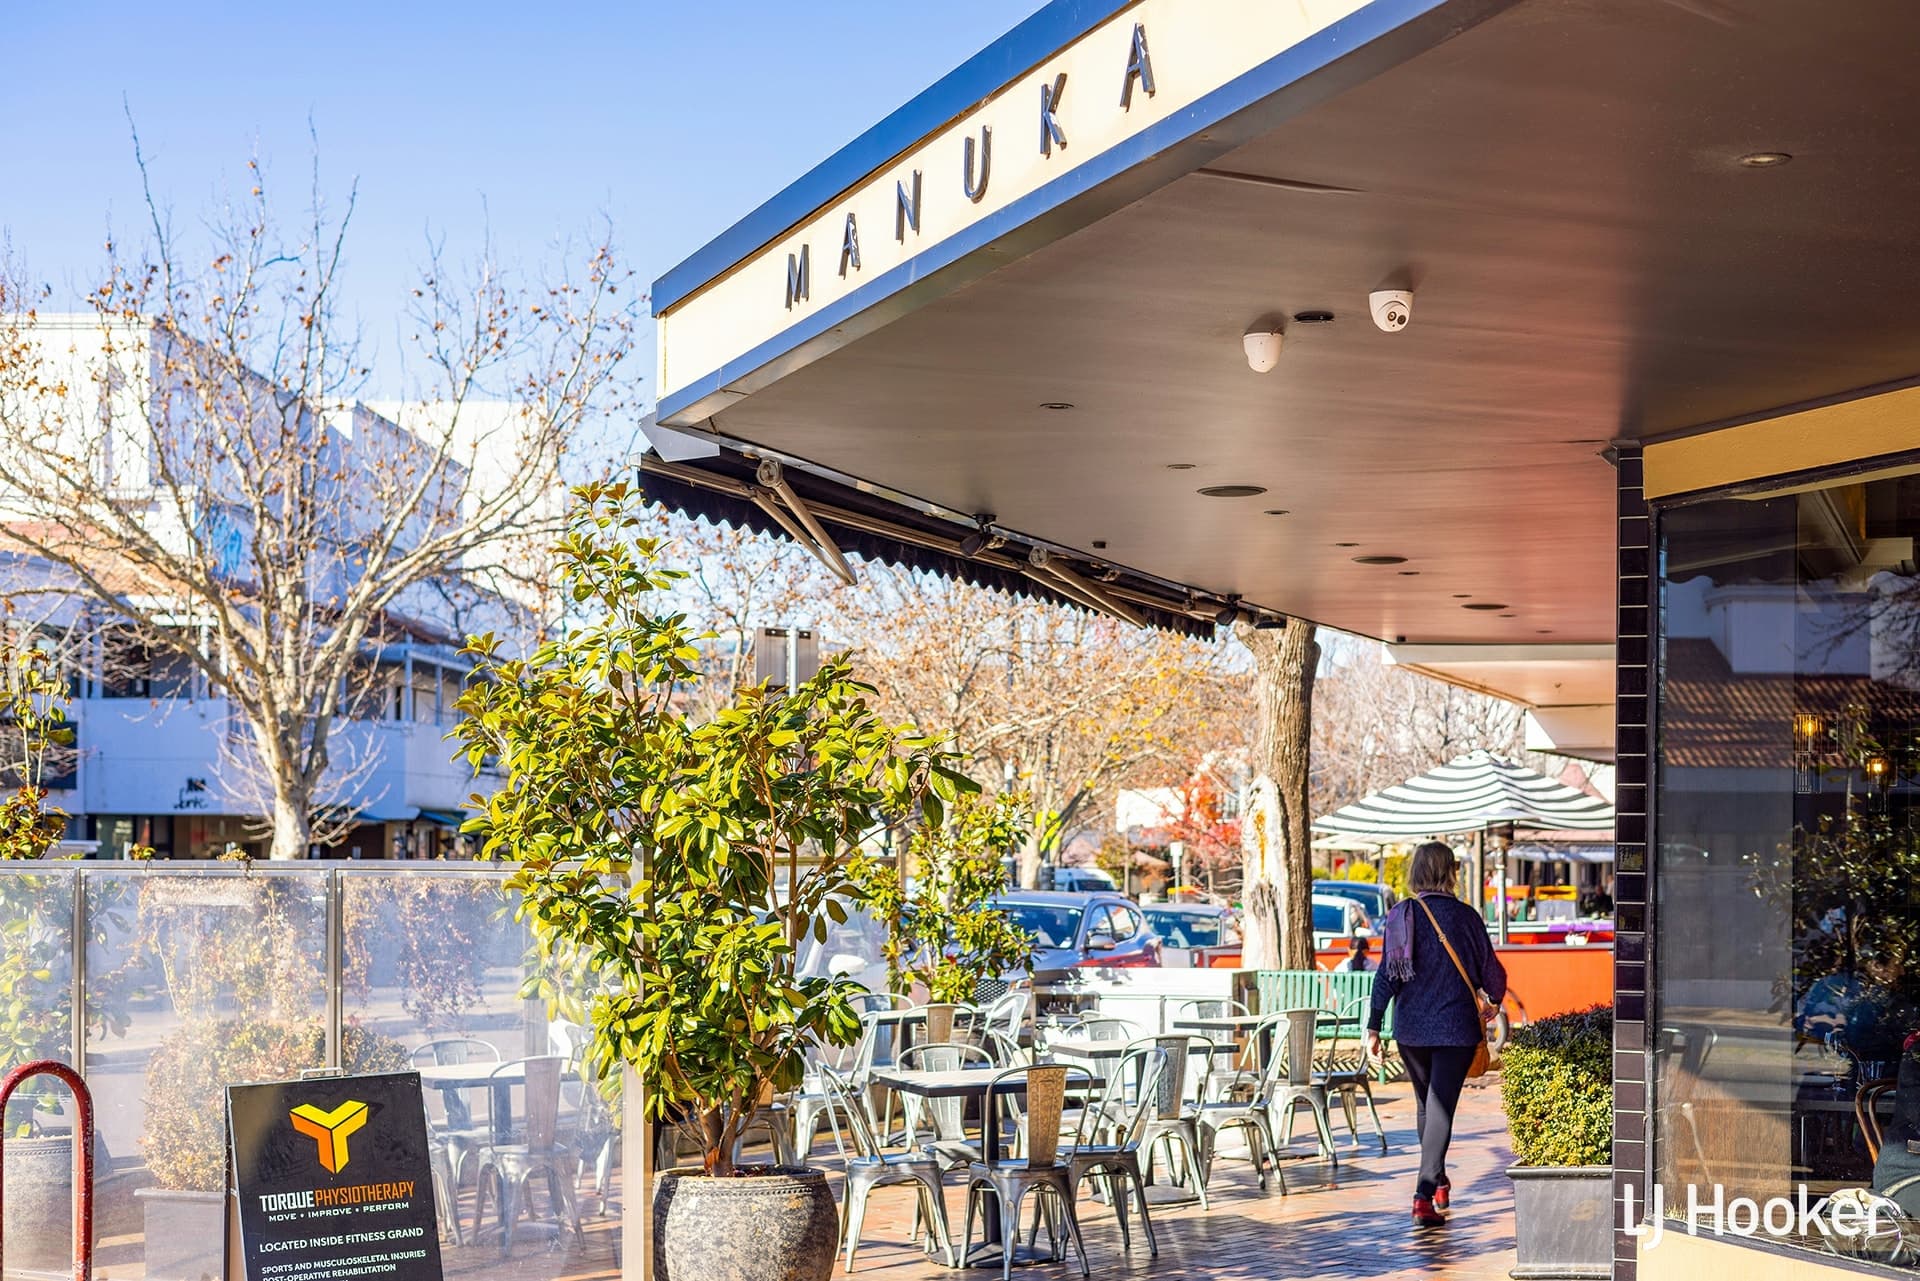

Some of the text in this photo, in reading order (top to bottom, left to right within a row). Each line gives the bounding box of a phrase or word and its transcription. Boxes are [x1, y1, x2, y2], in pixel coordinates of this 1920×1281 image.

[786, 23, 1156, 311] MANUKA
[269, 1202, 409, 1222] MOVE IMPROVE PERFORM
[260, 1227, 424, 1252] LOCATED INSIDE FITNESS GRAND
[262, 1250, 426, 1274] SPORTS AND MUSCULOSKELETAL INJURIES
[332, 1264, 396, 1277] REHABILITATION
